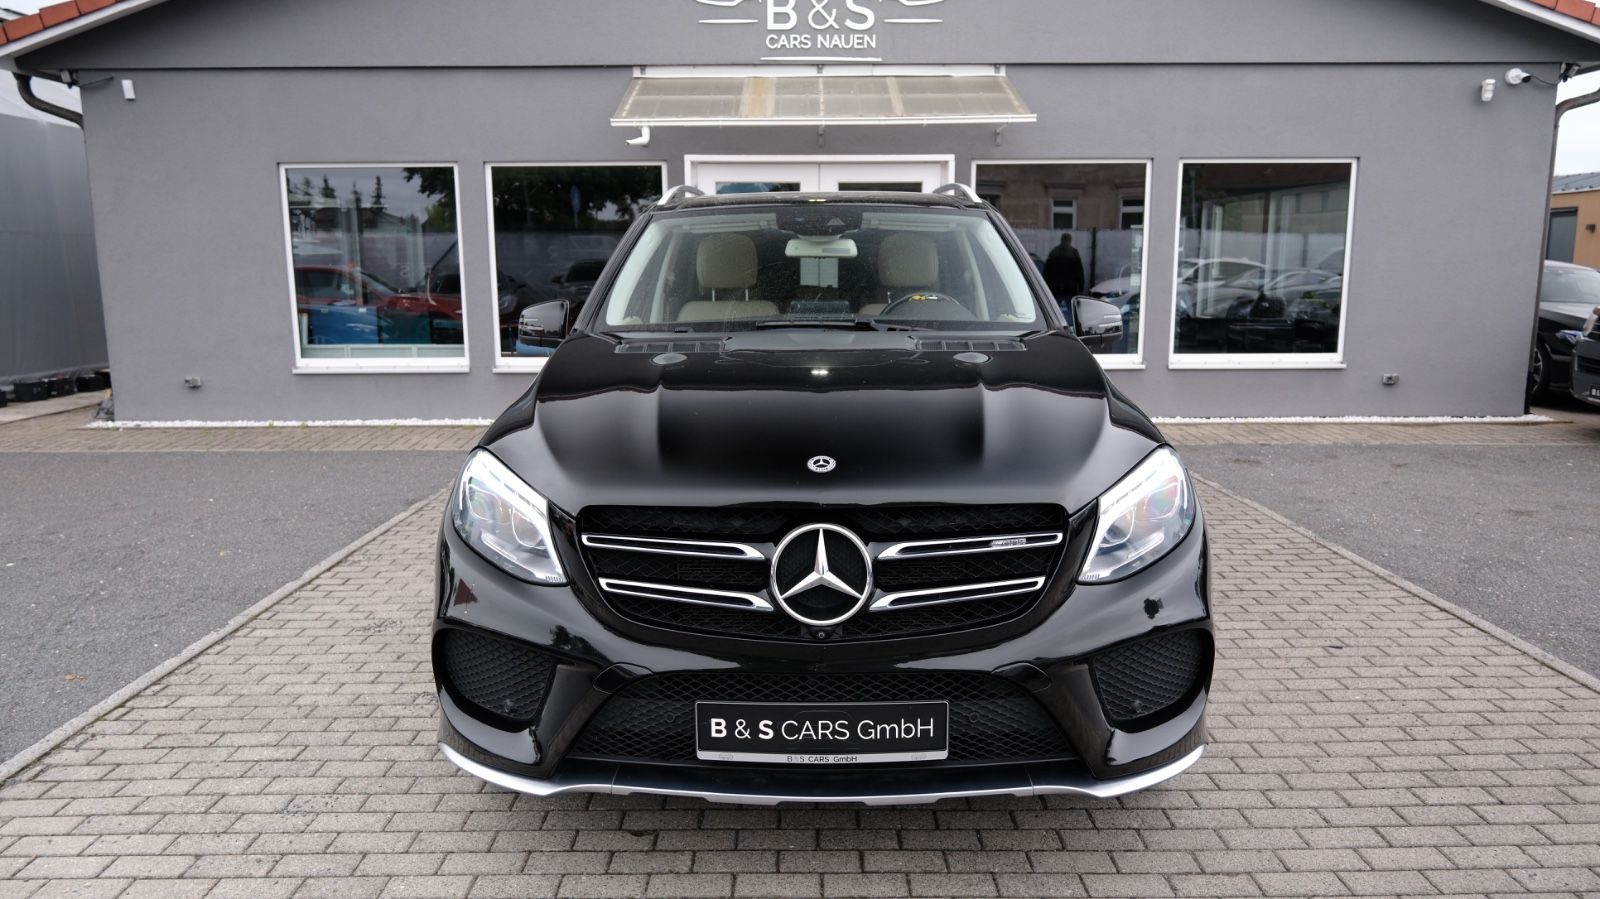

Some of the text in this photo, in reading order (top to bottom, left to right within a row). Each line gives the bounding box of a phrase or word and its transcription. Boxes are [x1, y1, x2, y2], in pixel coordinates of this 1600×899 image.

[765, 34, 877, 49] CARS NAUEN
[710, 717, 934, 740] B & S CARS GmbH
[808, 755, 830, 763] CARS
[833, 755, 858, 763] GmbH
